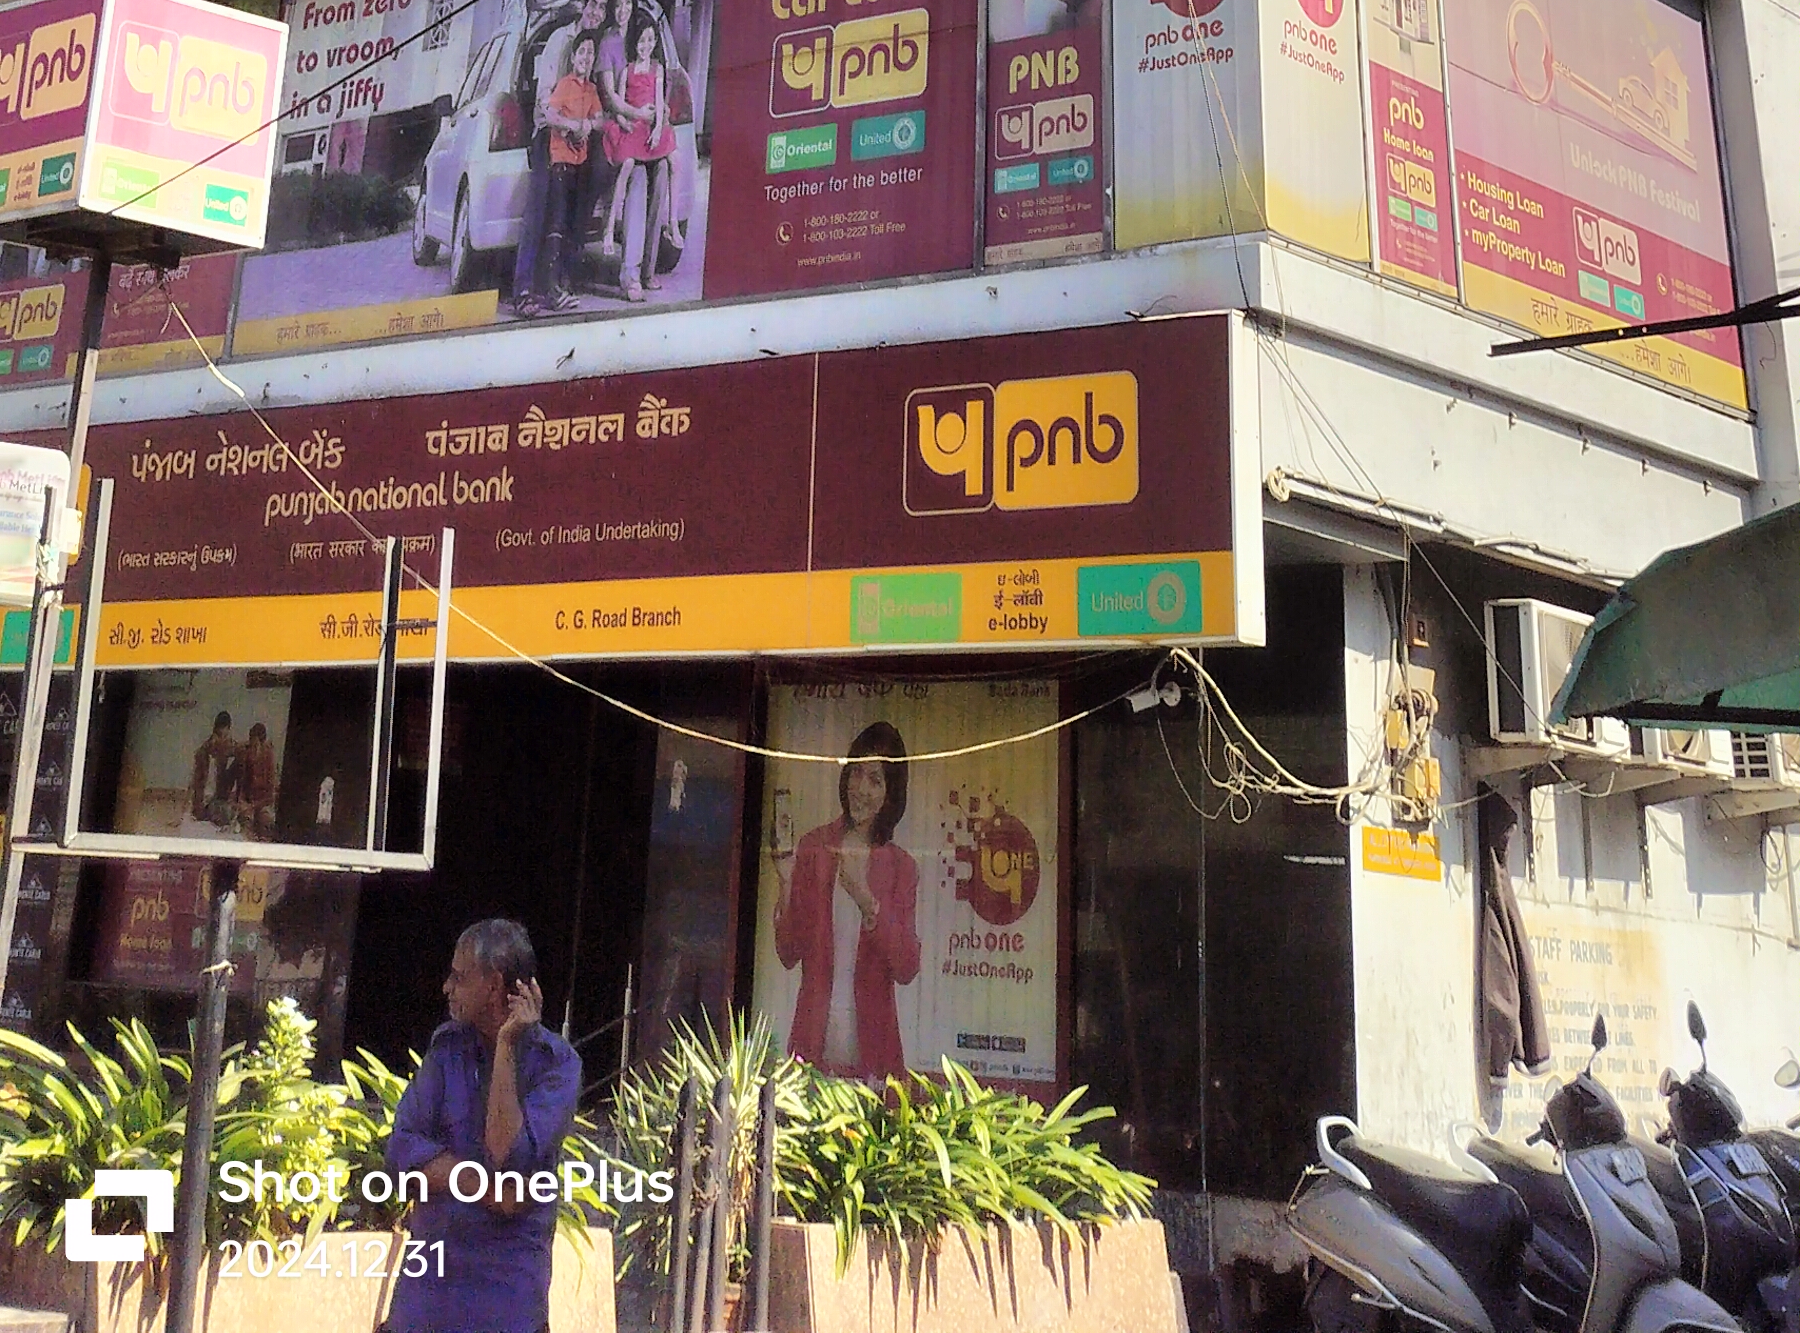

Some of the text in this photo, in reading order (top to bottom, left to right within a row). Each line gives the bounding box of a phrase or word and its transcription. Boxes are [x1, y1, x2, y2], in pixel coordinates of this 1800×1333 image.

[303, 0, 355, 30] From
[1145, 19, 1224, 54] pnb one
[1284, 20, 1338, 55] pnb one
[26, 28, 86, 108] pnb
[296, 49, 322, 75] to
[838, 23, 919, 96] pnb
[1009, 45, 1080, 94] PNB
[1138, 46, 1234, 73] #JustOneApp
[1280, 41, 1345, 85] #JustOneApp
[179, 61, 255, 119] pnb
[289, 78, 385, 121] in a jiffy
[1038, 103, 1089, 147] pnb
[1389, 96, 1425, 130] pnb
[786, 139, 833, 157] Oriental
[859, 132, 892, 147] United
[1383, 128, 1435, 162] Home loan
[764, 167, 923, 203] Together for the better
[1408, 172, 1433, 195] pnb
[1467, 171, 1544, 219] Housing Loan
[1569, 142, 1701, 223] Unlock PNB Festival
[1469, 199, 1520, 235] Car Loan
[1471, 228, 1535, 270] myProperty
[1538, 251, 1566, 278] Loan
[1604, 233, 1636, 267] pnb
[19, 292, 57, 334] pnb
[426, 392, 691, 457] पंजाब नैशनल बैंक
[1006, 391, 1125, 493] pnb
[206, 430, 289, 476] નેશનલ
[348, 471, 448, 513] national
[453, 465, 514, 505] bank
[496, 518, 684, 550] (Govt. of India Undertaking)
[591, 606, 627, 628] Road
[632, 605, 682, 627] Branch
[1091, 591, 1144, 613] United
[988, 612, 1049, 635] e-lobby
[131, 888, 169, 929] pnb
[949, 926, 1024, 955] pnb one
[1569, 939, 1613, 966] PARKING
[942, 959, 1034, 984] #JustOneApp
